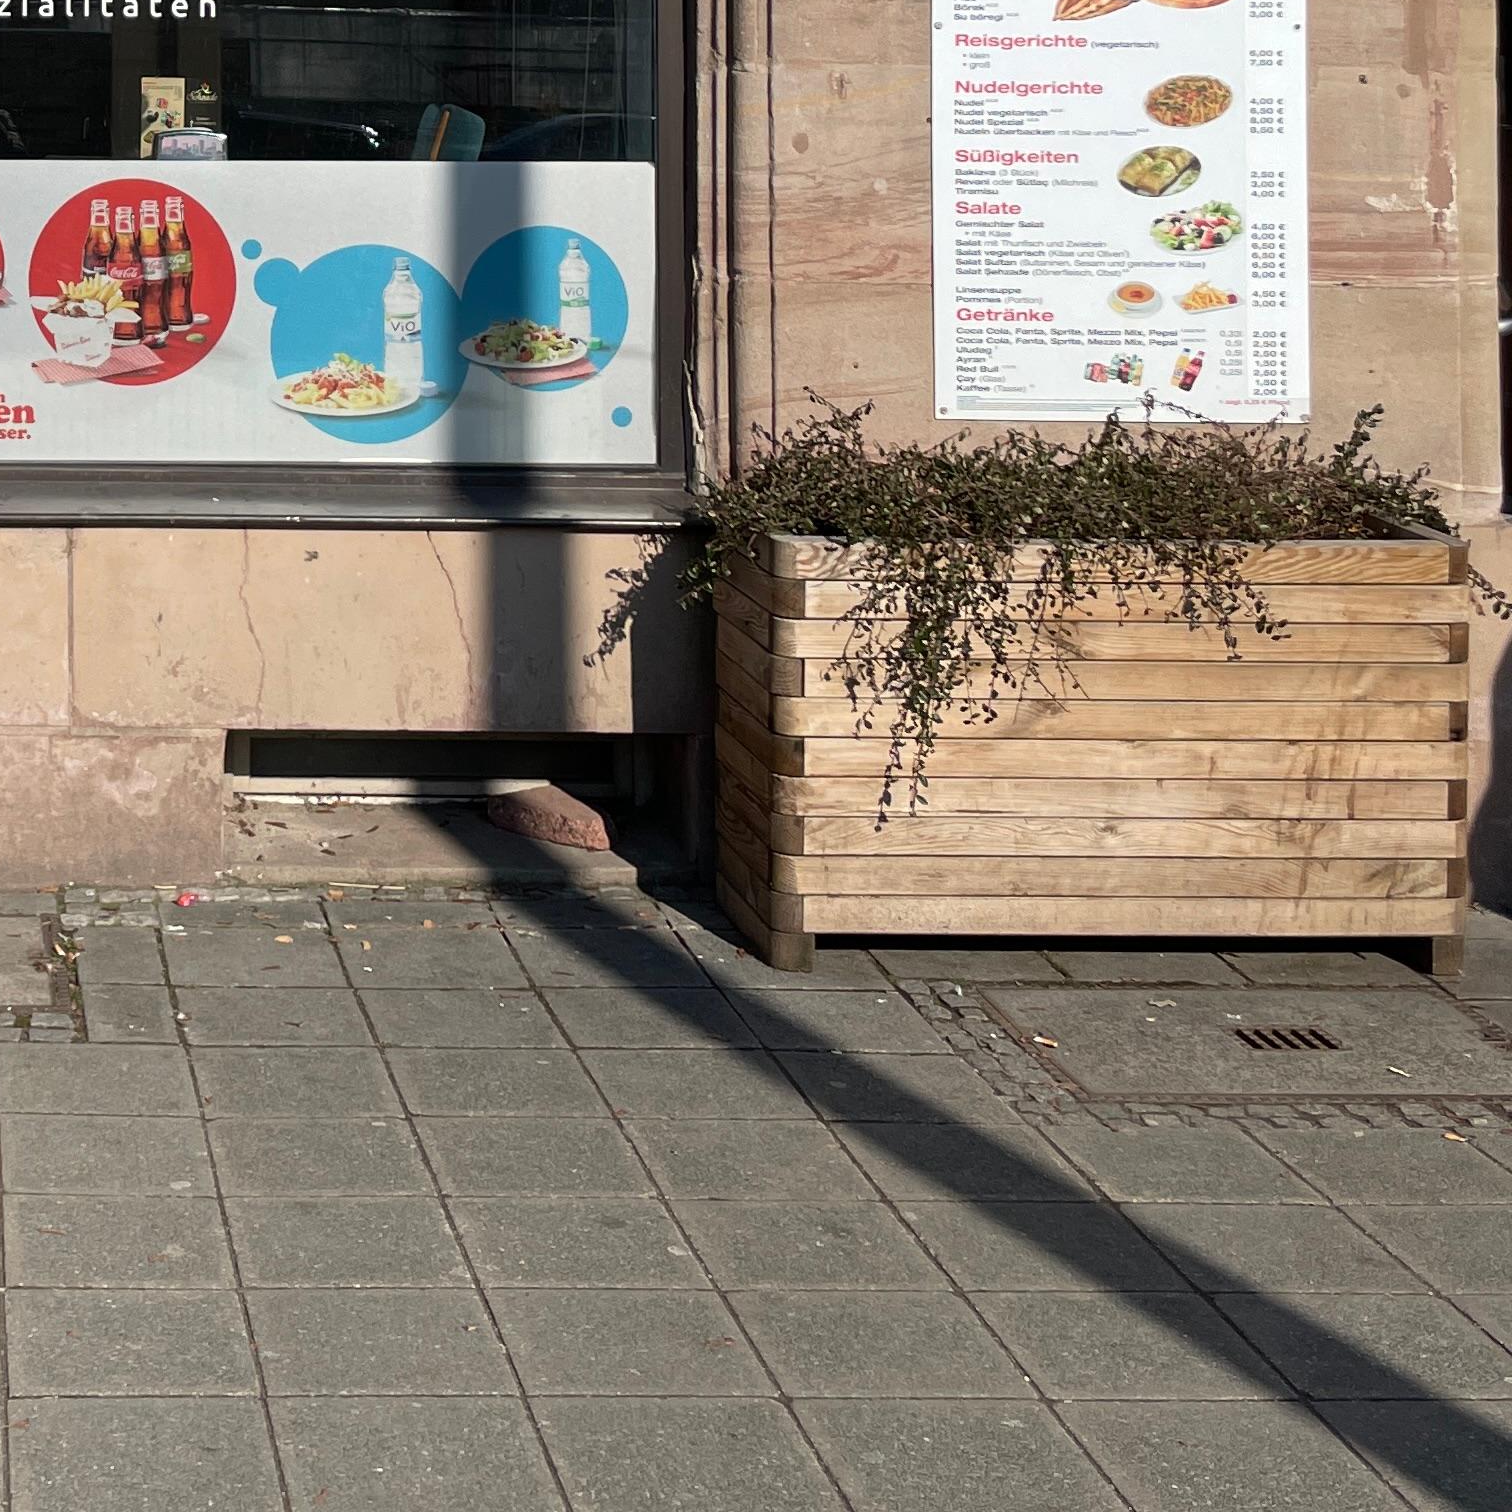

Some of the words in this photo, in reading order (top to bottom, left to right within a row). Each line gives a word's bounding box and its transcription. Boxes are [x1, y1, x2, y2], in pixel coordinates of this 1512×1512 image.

[955, 34, 1087, 50] Reisgerichte
[955, 81, 1103, 96] Nudelgerichte
[955, 150, 1078, 166] Süßigkeiten
[956, 202, 1021, 214] Salate
[956, 308, 1054, 322] Getränke
